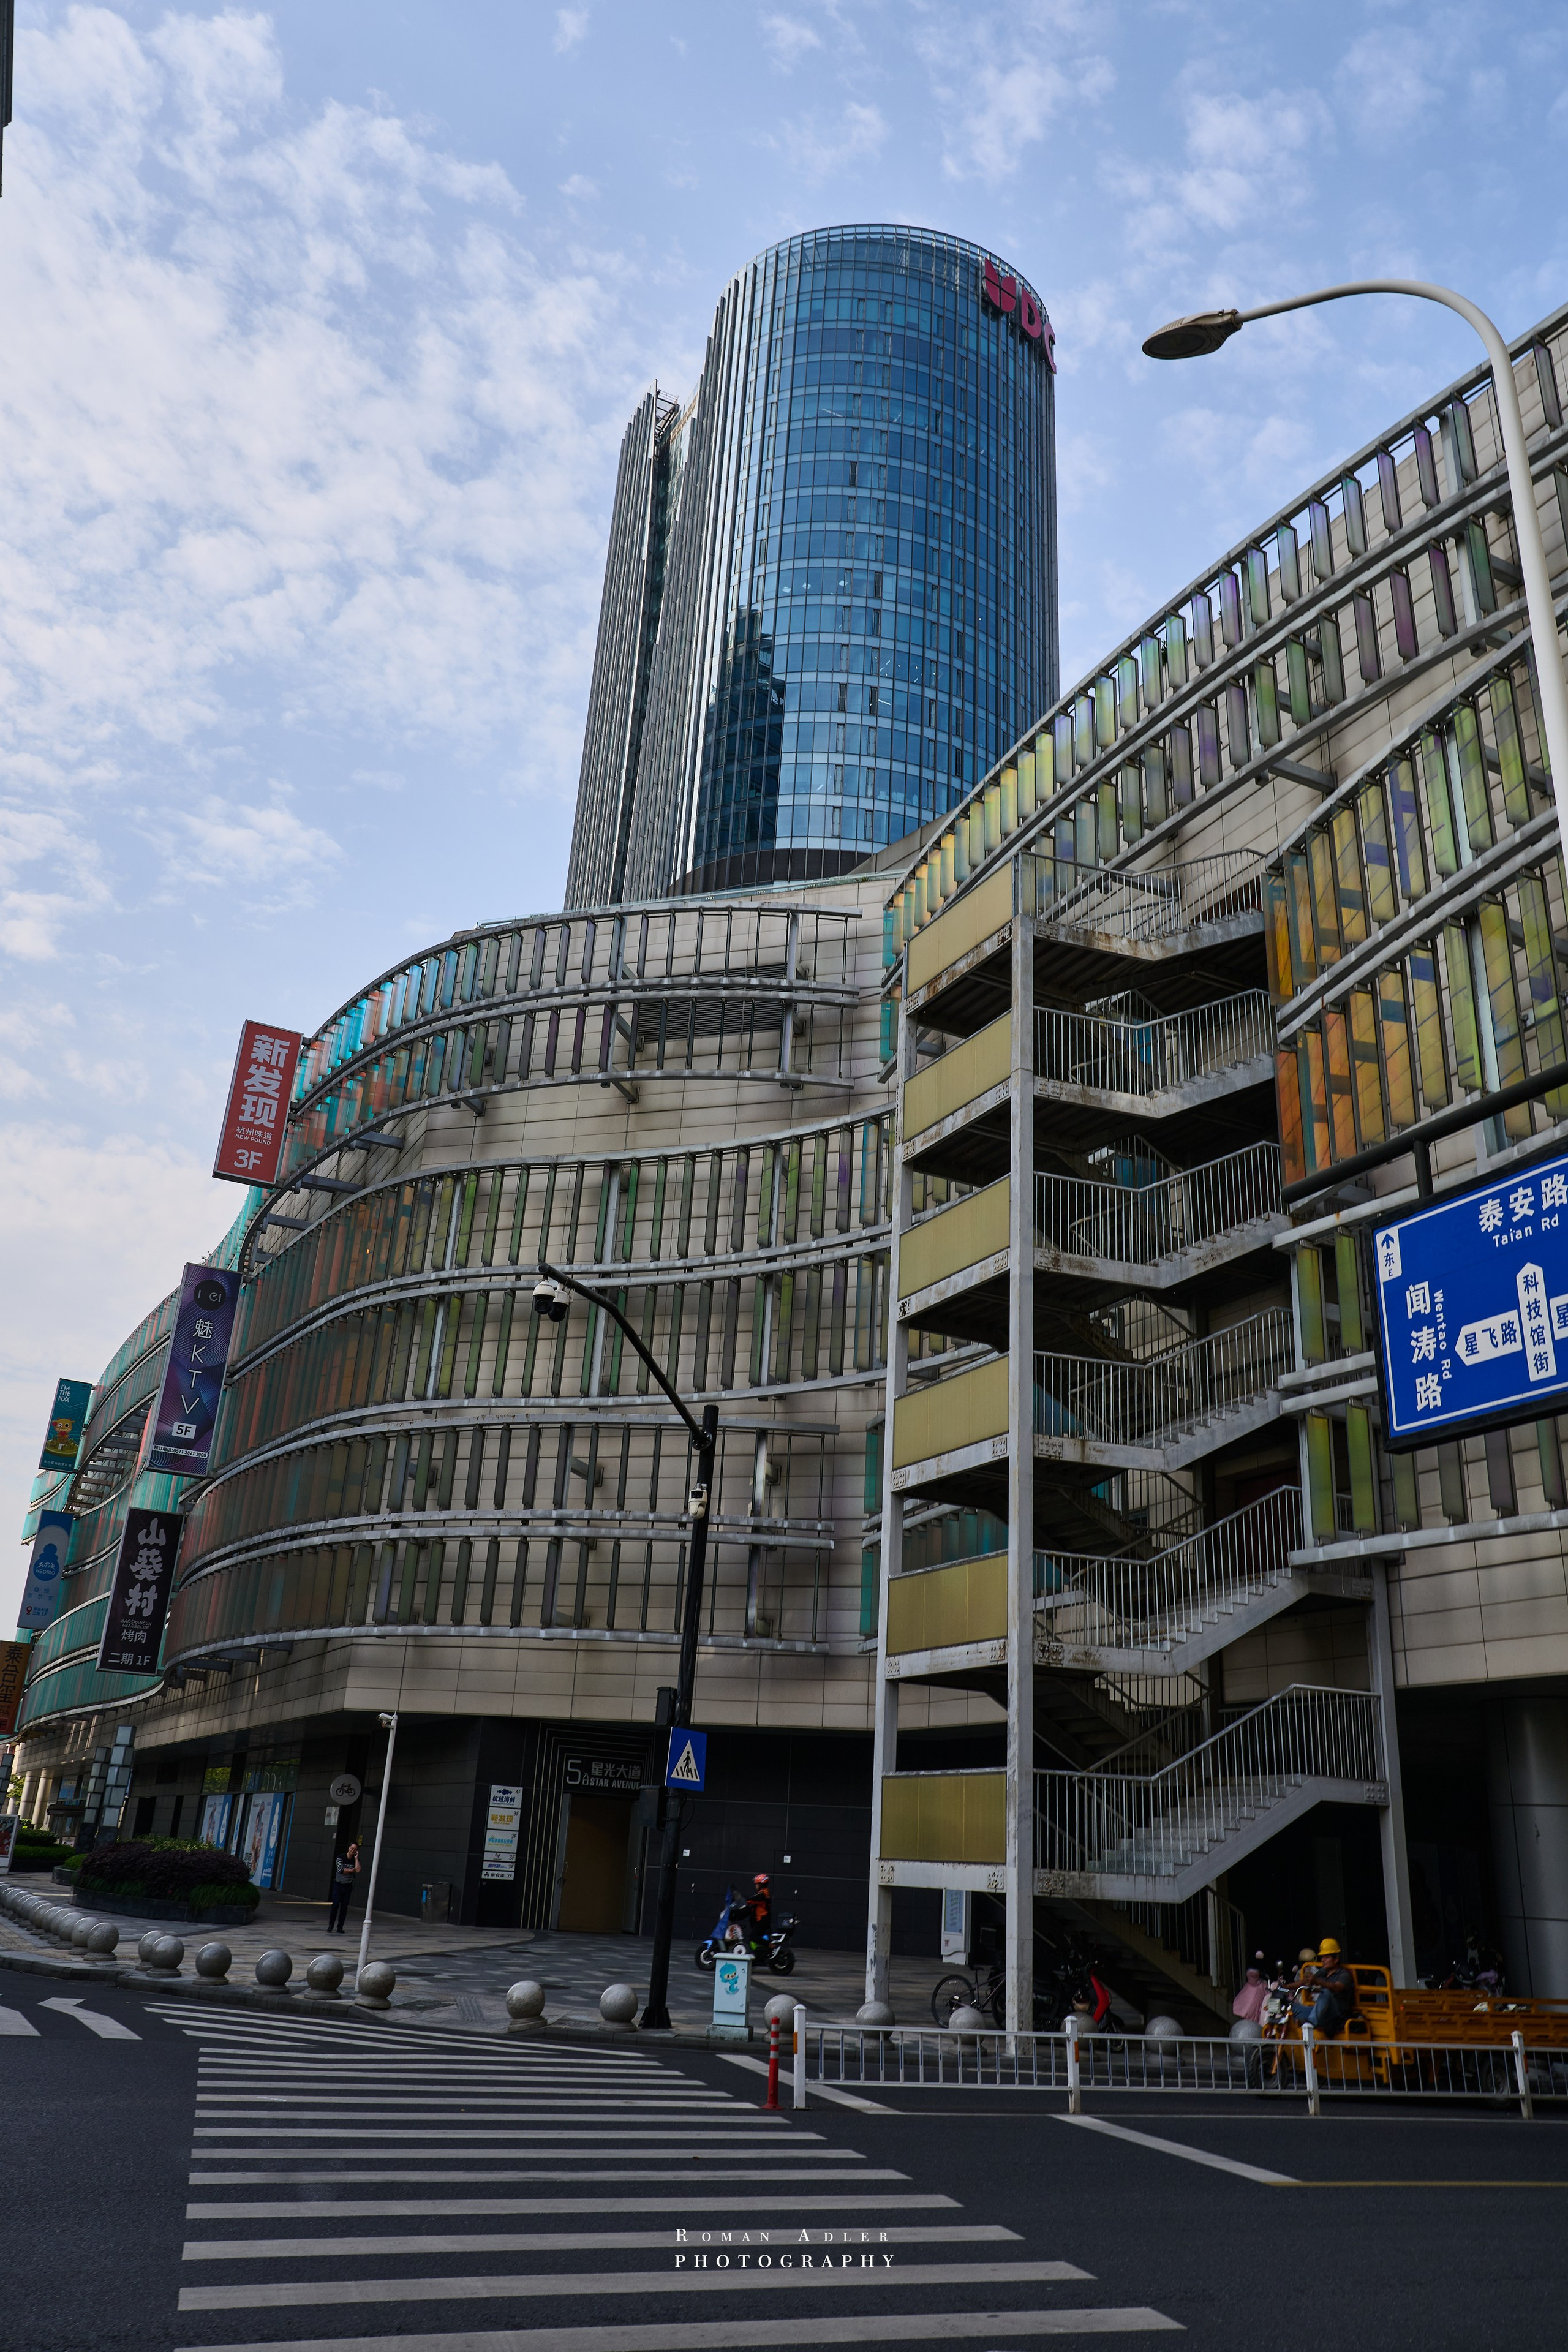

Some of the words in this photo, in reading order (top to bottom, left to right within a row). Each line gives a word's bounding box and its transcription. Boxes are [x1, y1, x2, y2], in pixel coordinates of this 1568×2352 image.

[239, 1034, 290, 1128] 新发现
[236, 1125, 273, 1141] 杭州味道
[251, 1137, 271, 1145] FOUND
[234, 1149, 263, 1170] 3F
[1479, 1173, 1568, 1233] 泰安路
[1541, 1213, 1559, 1231] Rd
[1384, 1252, 1395, 1268] 东
[1523, 1271, 1550, 1374] 科技馆街
[1434, 1289, 1447, 1351] Wentao
[1441, 1360, 1452, 1380] Rd
[1464, 1315, 1518, 1357] 星飞路
[1406, 1281, 1442, 1412] 闻涛路
[176, 1425, 192, 1436] 5F
[36, 1561, 56, 1570] SUPER
[120, 1629, 147, 1643] 烤肉
[108, 1652, 134, 1665] 二期
[136, 1655, 151, 1666] 1F
[0, 1645, 23, 1703] 泰合玺
[567, 1759, 582, 1785] 5
[582, 1772, 589, 1785] 入口
[591, 1761, 641, 1779] 星光大道
[590, 1777, 609, 1787] STAR
[611, 1779, 641, 1790] AVENUE
[491, 1814, 513, 1823] 新发现
